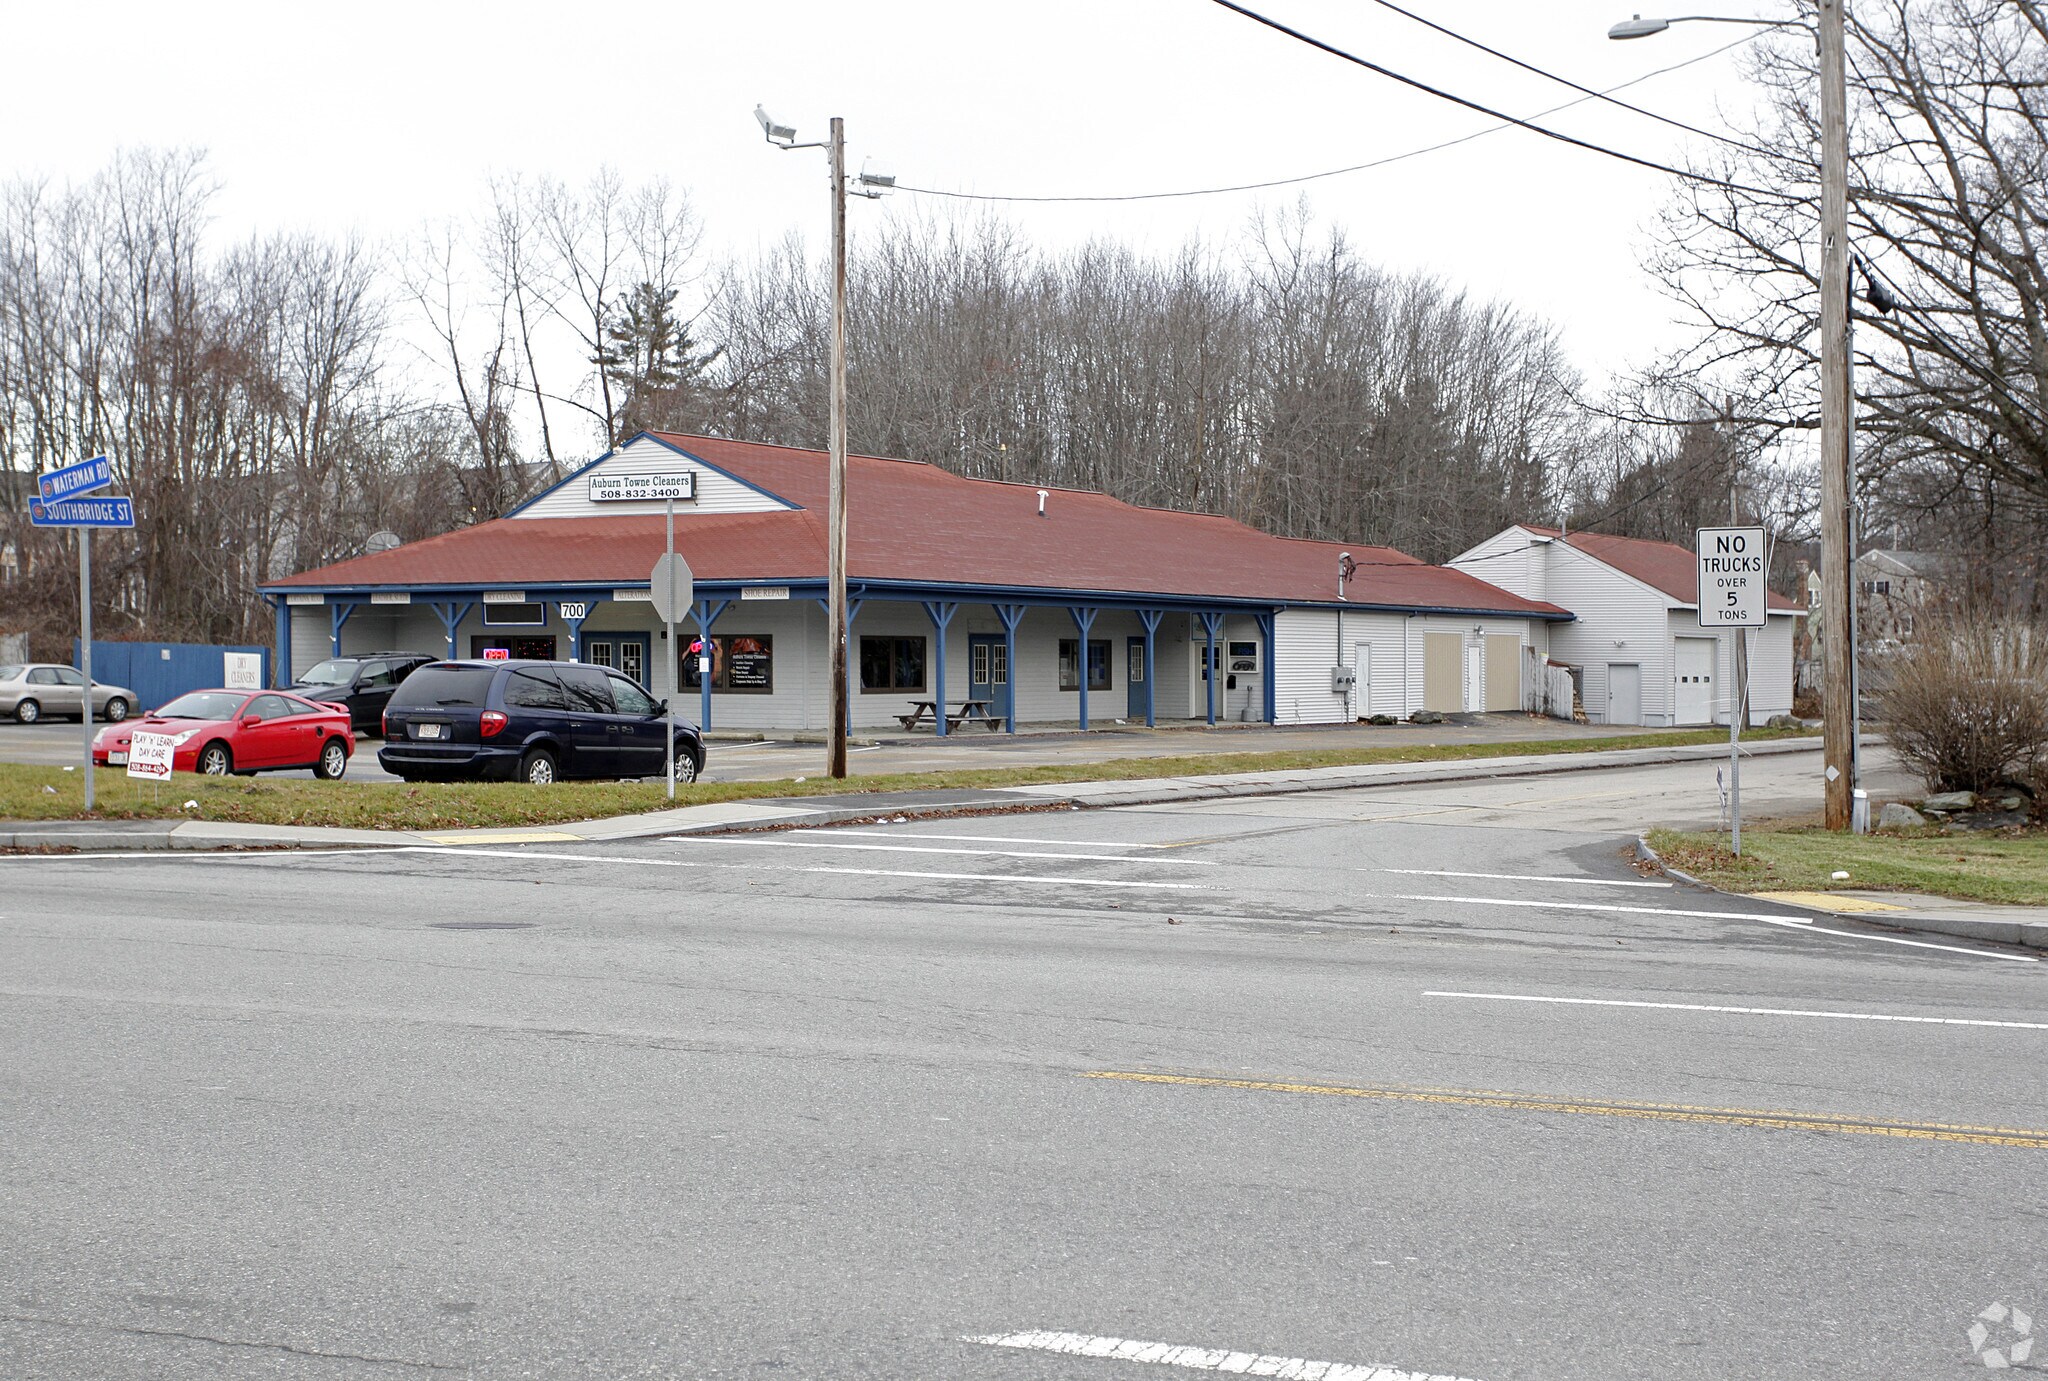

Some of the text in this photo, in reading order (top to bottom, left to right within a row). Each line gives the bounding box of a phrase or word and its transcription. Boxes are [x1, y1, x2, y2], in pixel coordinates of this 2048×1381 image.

[52, 461, 107, 495] WATERMAN RD
[591, 476, 689, 488] Auburn Towne Cleaners
[600, 488, 680, 499] 508-832-3400
[46, 503, 129, 521] SOUTHBRIDGE ST
[1716, 535, 1746, 553] NO
[1703, 556, 1761, 573] TRUCKS
[1717, 577, 1747, 588] OVER
[618, 590, 652, 600] ALTERATION
[744, 588, 787, 597] SHOE REPAIR
[1727, 591, 1738, 607] 5
[563, 604, 584, 618] 700
[1718, 610, 1747, 620] TONS
[237, 657, 247, 669] DRY
[231, 672, 255, 683] CLEANERS
[133, 733, 147, 744] PLAY
[156, 737, 174, 747] LEARN
[139, 748, 165, 759] DAY CARE
